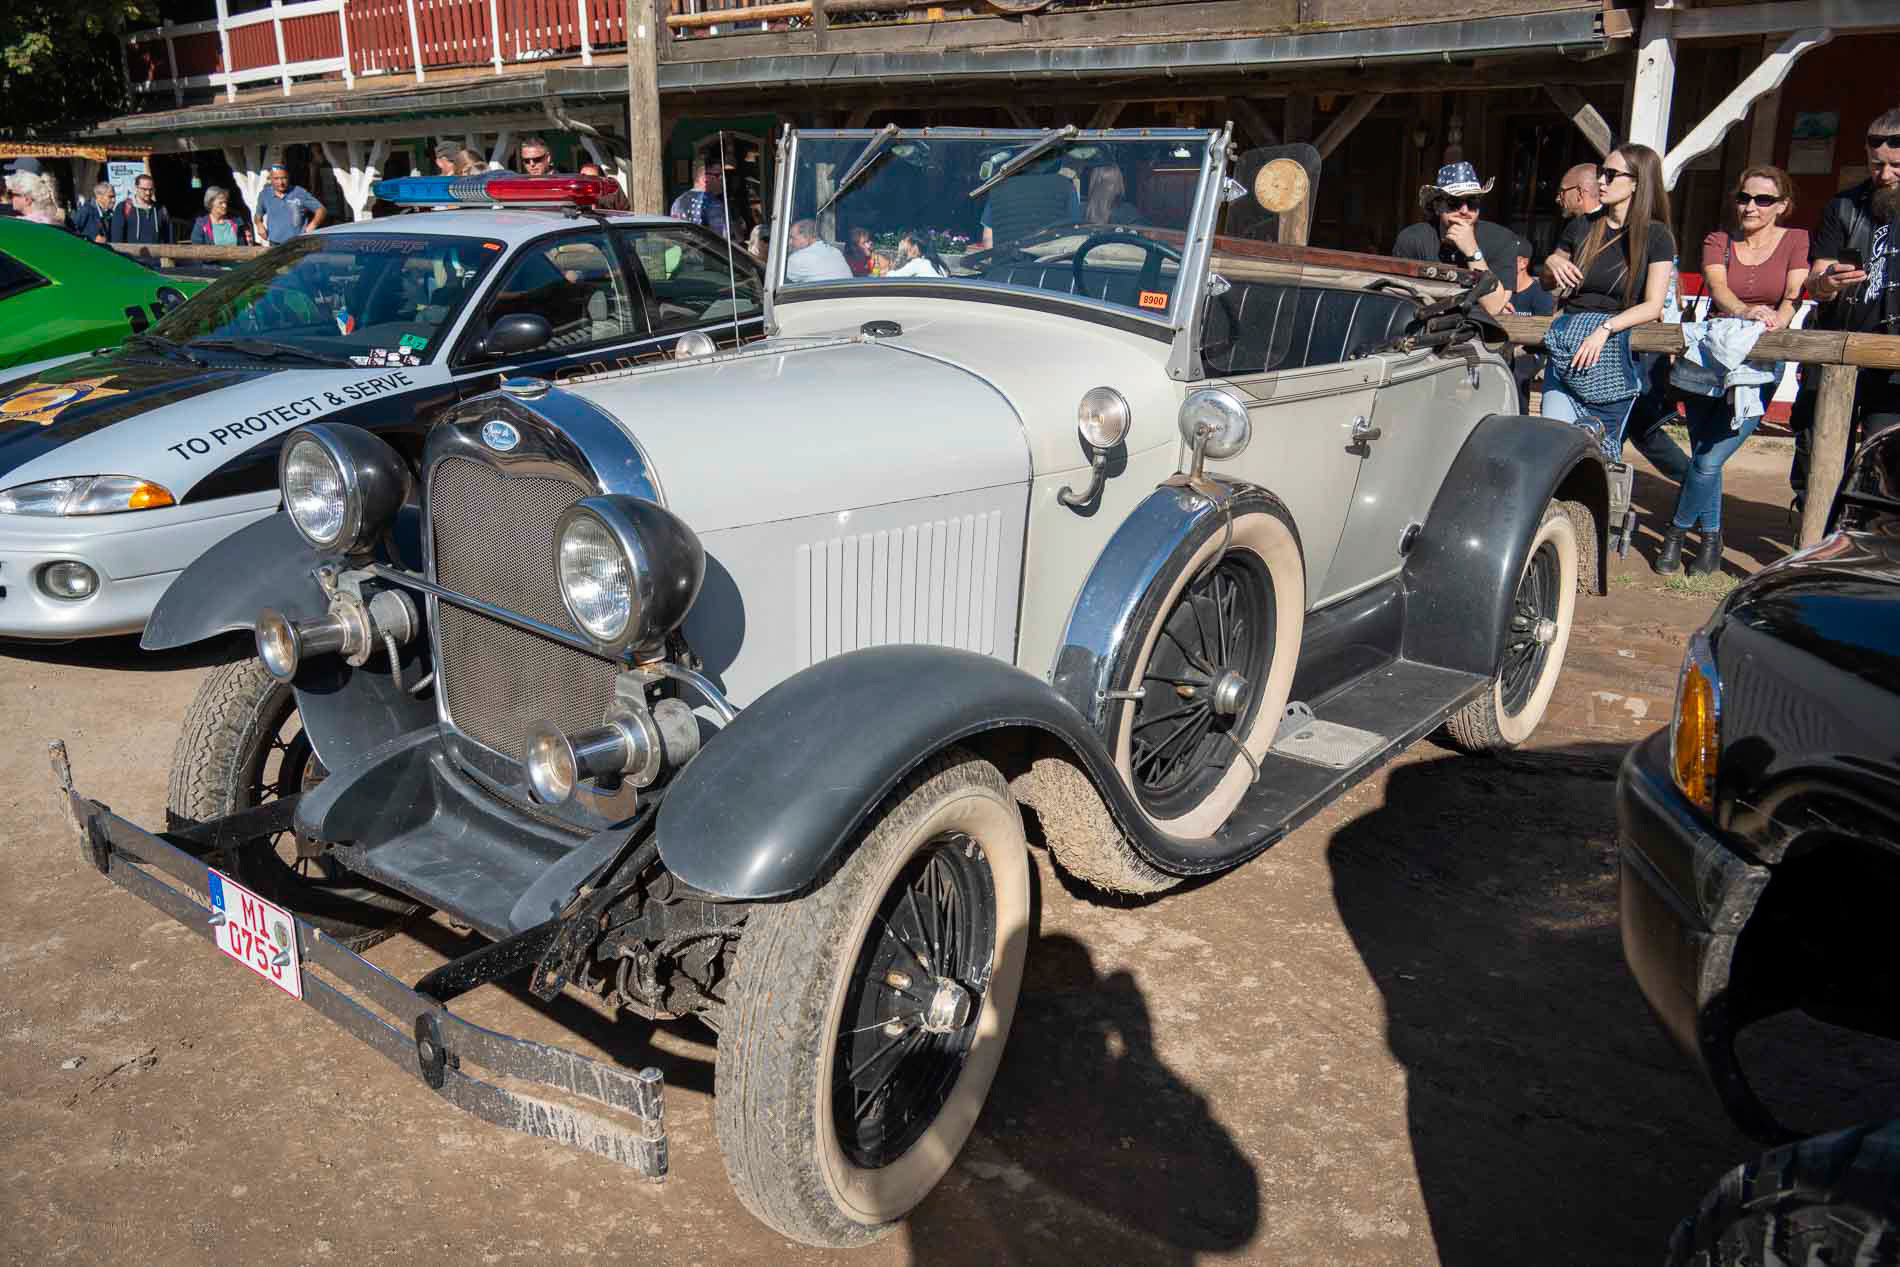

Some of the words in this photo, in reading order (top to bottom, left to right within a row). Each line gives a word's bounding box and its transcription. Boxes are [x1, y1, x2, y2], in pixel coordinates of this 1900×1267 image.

[1143, 295, 1164, 305] 8900
[168, 438, 210, 461] TO
[209, 396, 323, 445] PROTECT
[324, 391, 344, 405] &
[342, 371, 413, 400] SERVE
[241, 893, 271, 940] MI
